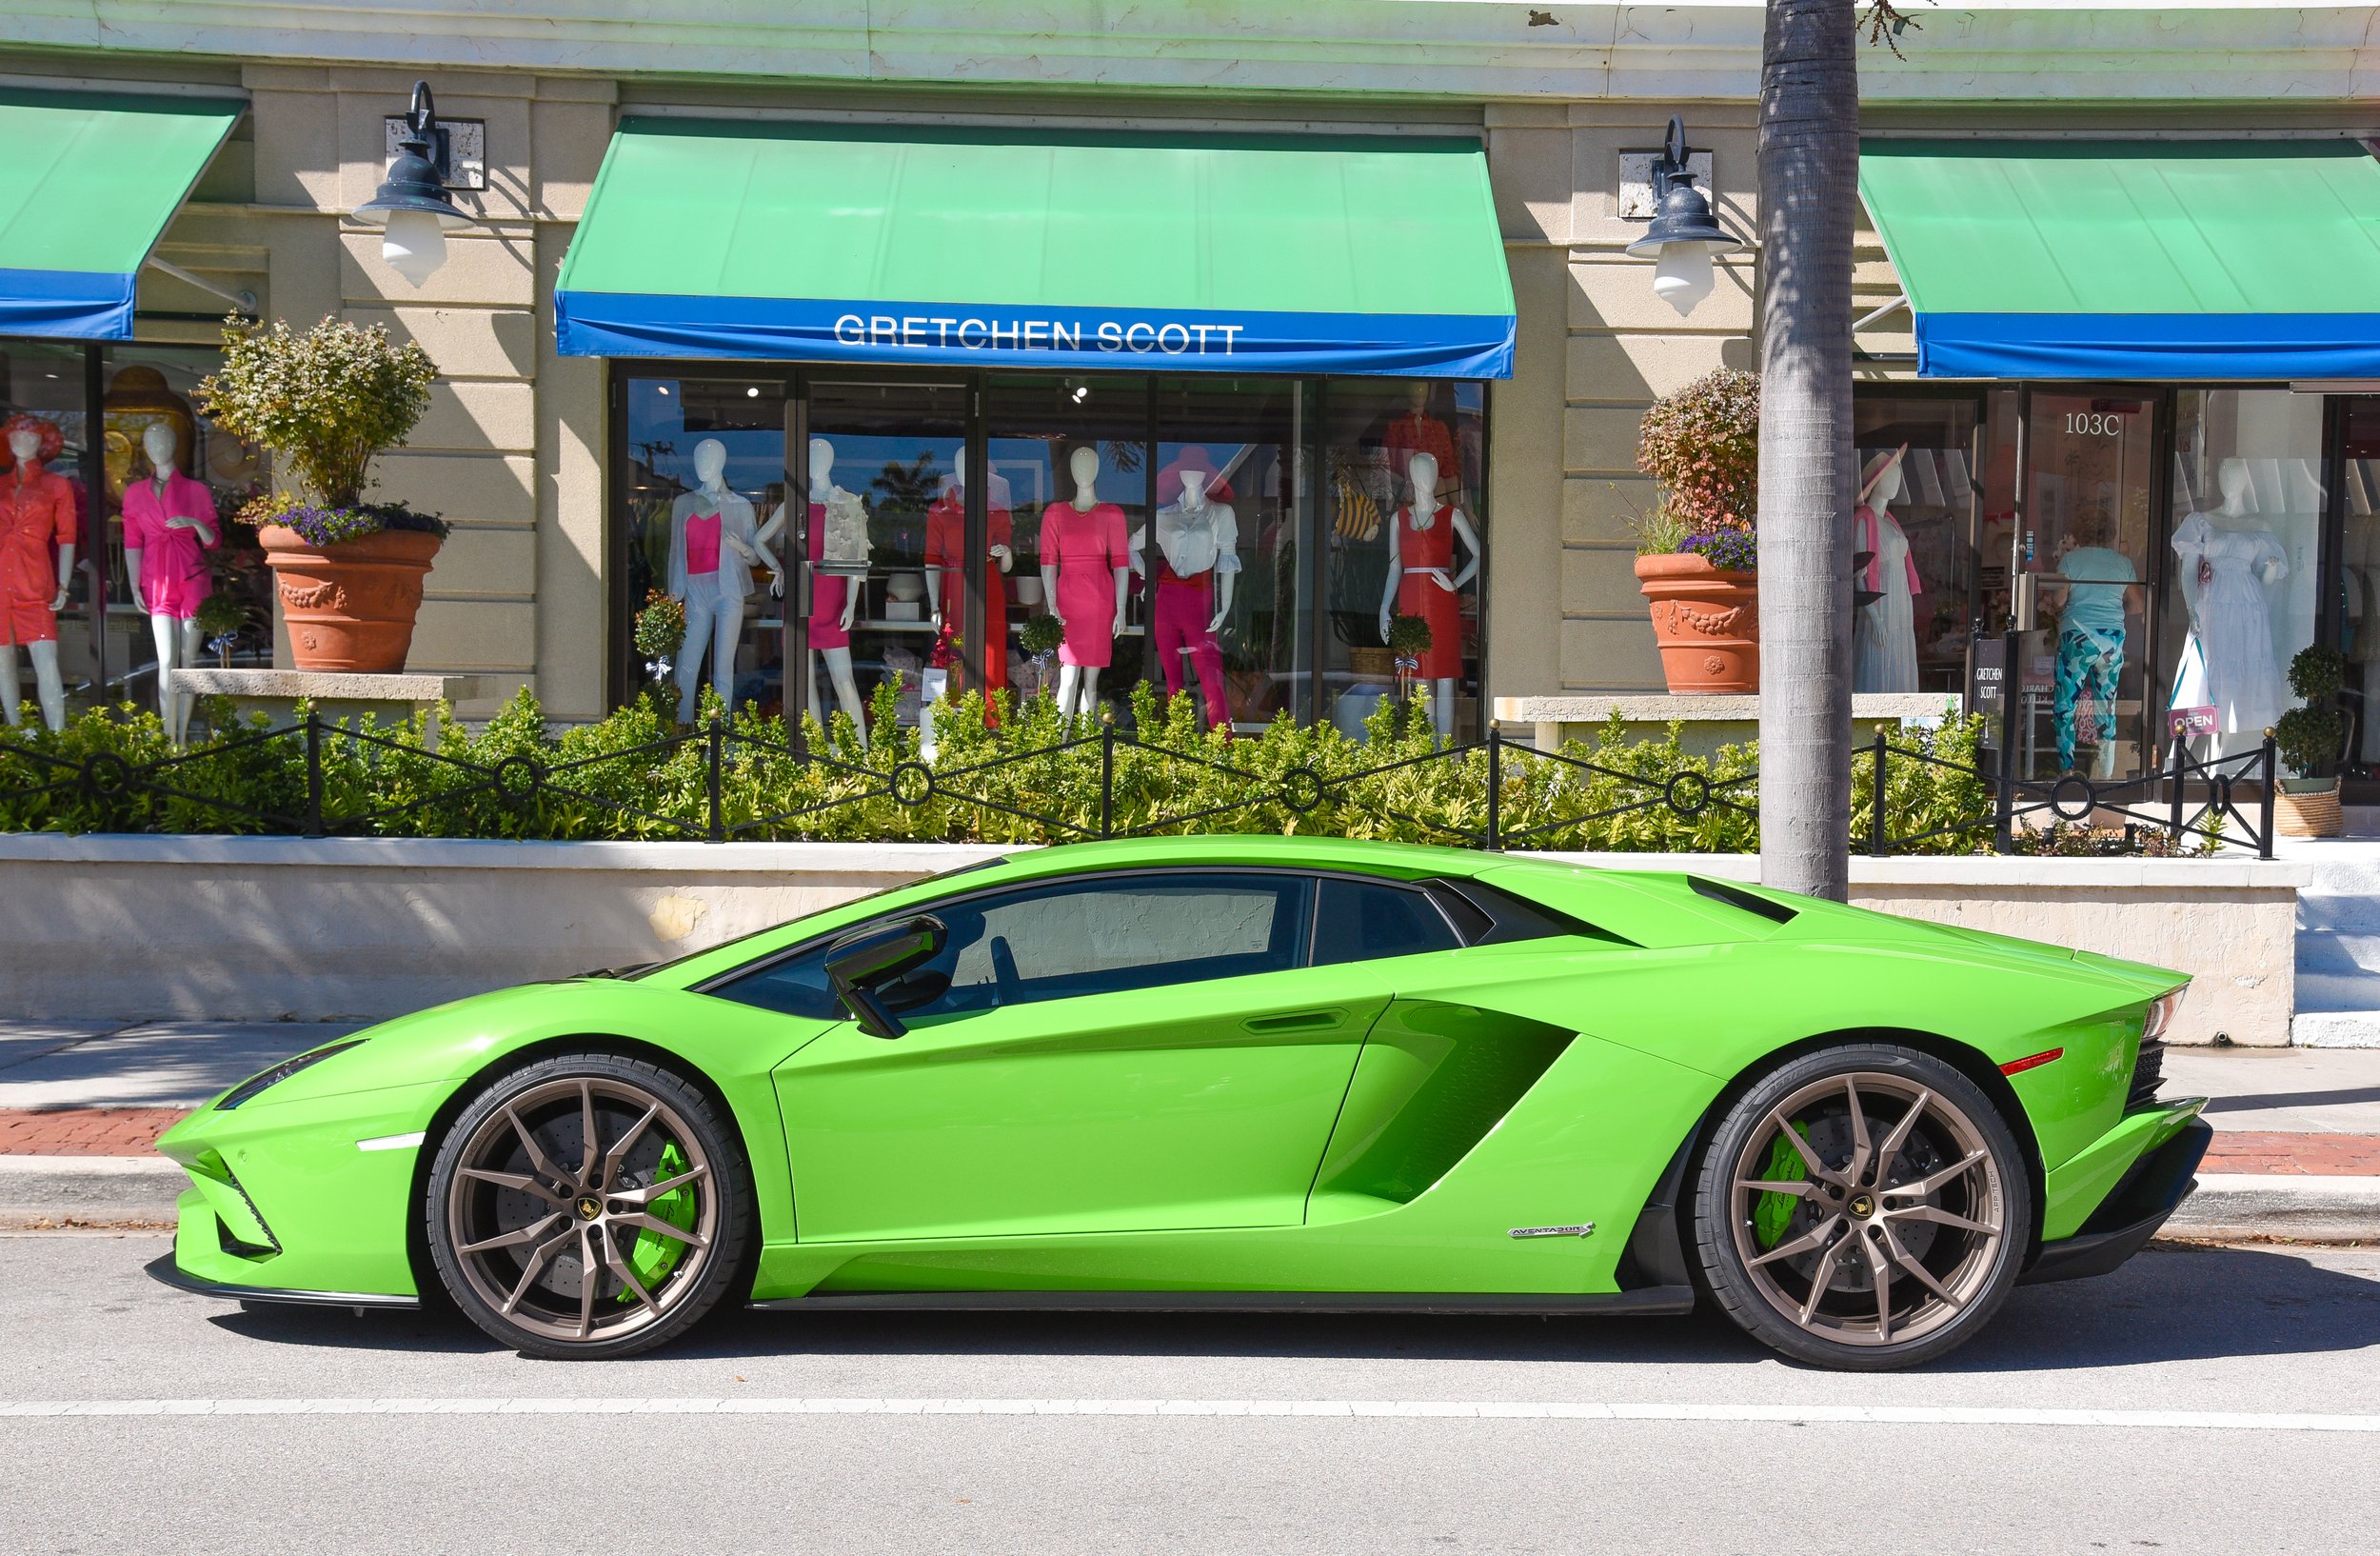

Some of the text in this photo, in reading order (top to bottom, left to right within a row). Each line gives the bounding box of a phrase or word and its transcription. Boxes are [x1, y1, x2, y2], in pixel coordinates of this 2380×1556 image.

[834, 314, 1243, 355] GRETCHEN SCOTT
[2065, 412, 2119, 436] 103C
[1976, 668, 2003, 681] GRETCHEN
[1980, 686, 1997, 699] SCOTT
[2174, 715, 2213, 728] OPEN
